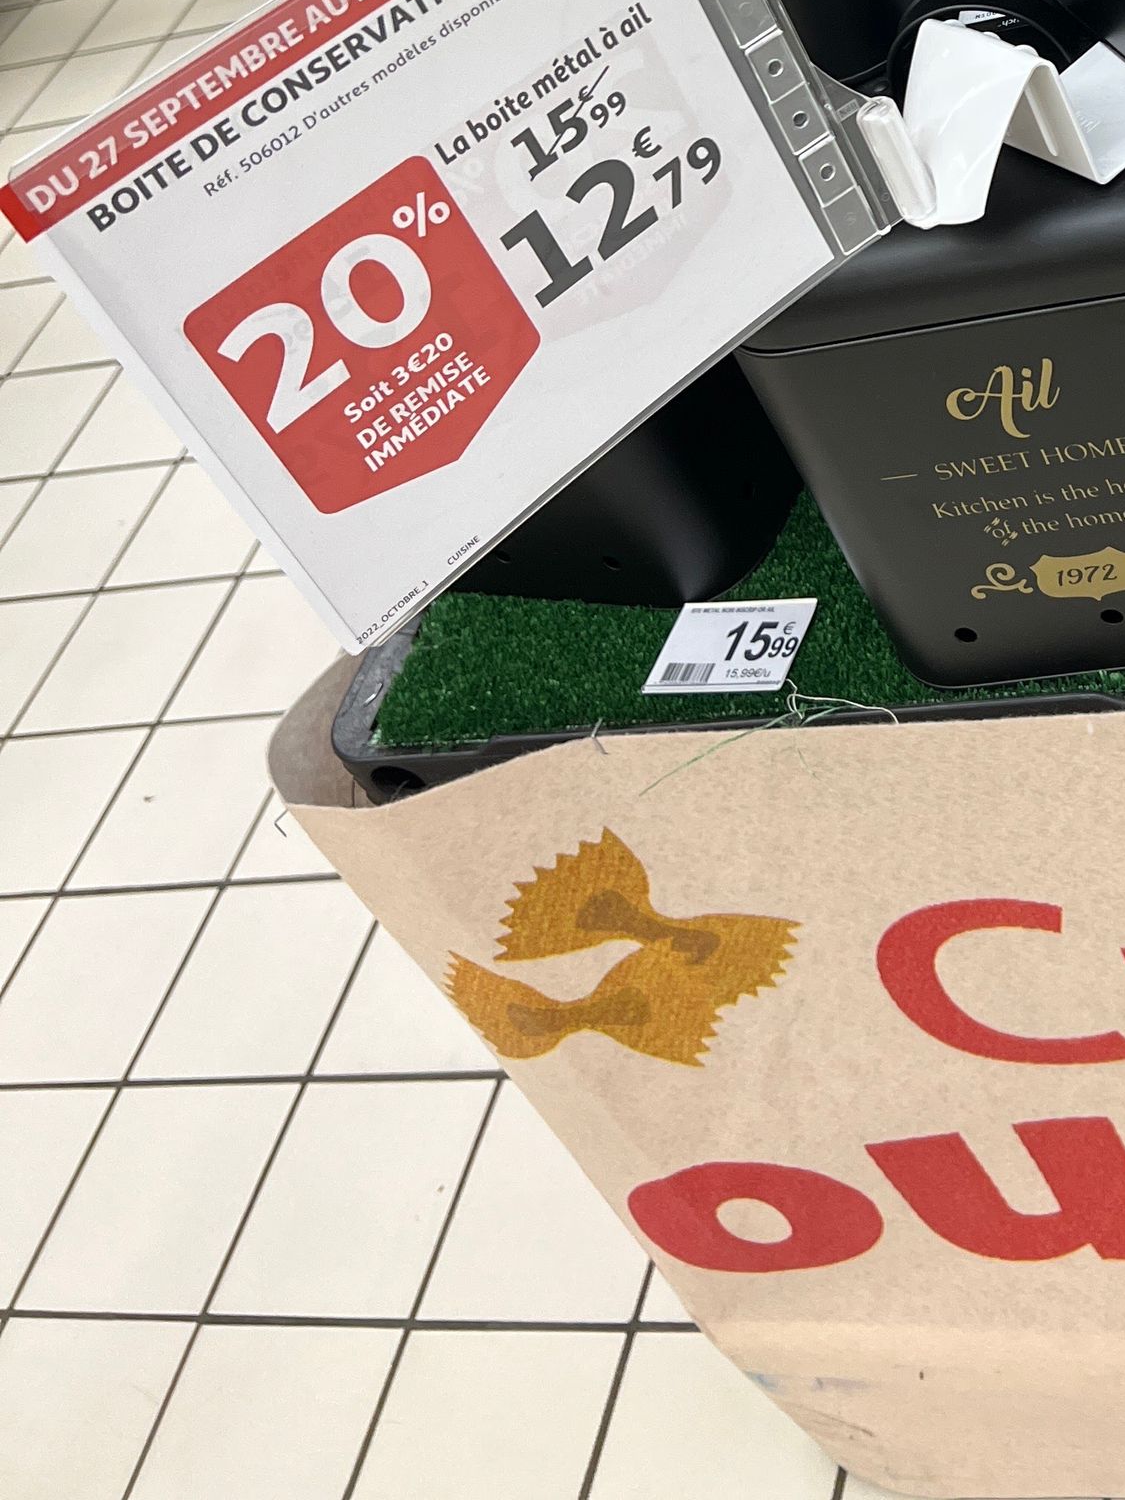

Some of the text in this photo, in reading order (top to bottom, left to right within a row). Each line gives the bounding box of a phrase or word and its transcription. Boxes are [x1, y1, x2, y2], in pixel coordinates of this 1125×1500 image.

[26, 166, 81, 214] DU
[80, 135, 119, 181] 27
[123, 18, 305, 150] SEPTEMBRE
[203, 172, 239, 197] Réf.
[239, 125, 302, 174] 506012
[302, 79, 370, 131] D'autres
[372, 34, 437, 85] modèles
[434, 2, 653, 165] La boite métal à ail
[87, 149, 193, 233] BOITE
[190, 117, 242, 162] DE
[217, 190, 452, 435] 20%
[343, 332, 454, 425] Soit 3€20
[355, 351, 474, 451] DE REMISE
[364, 365, 492, 474] IMMÉDIATE
[945, 357, 1061, 439] Ail
[931, 492, 1028, 520] Kitchen
[1033, 489, 1055, 507] is
[1060, 482, 1100, 502] the
[934, 450, 1032, 482] SWEET
[447, 535, 480, 566] CUISINE
[1020, 516, 1060, 536] the
[1057, 563, 1118, 587] 1972
